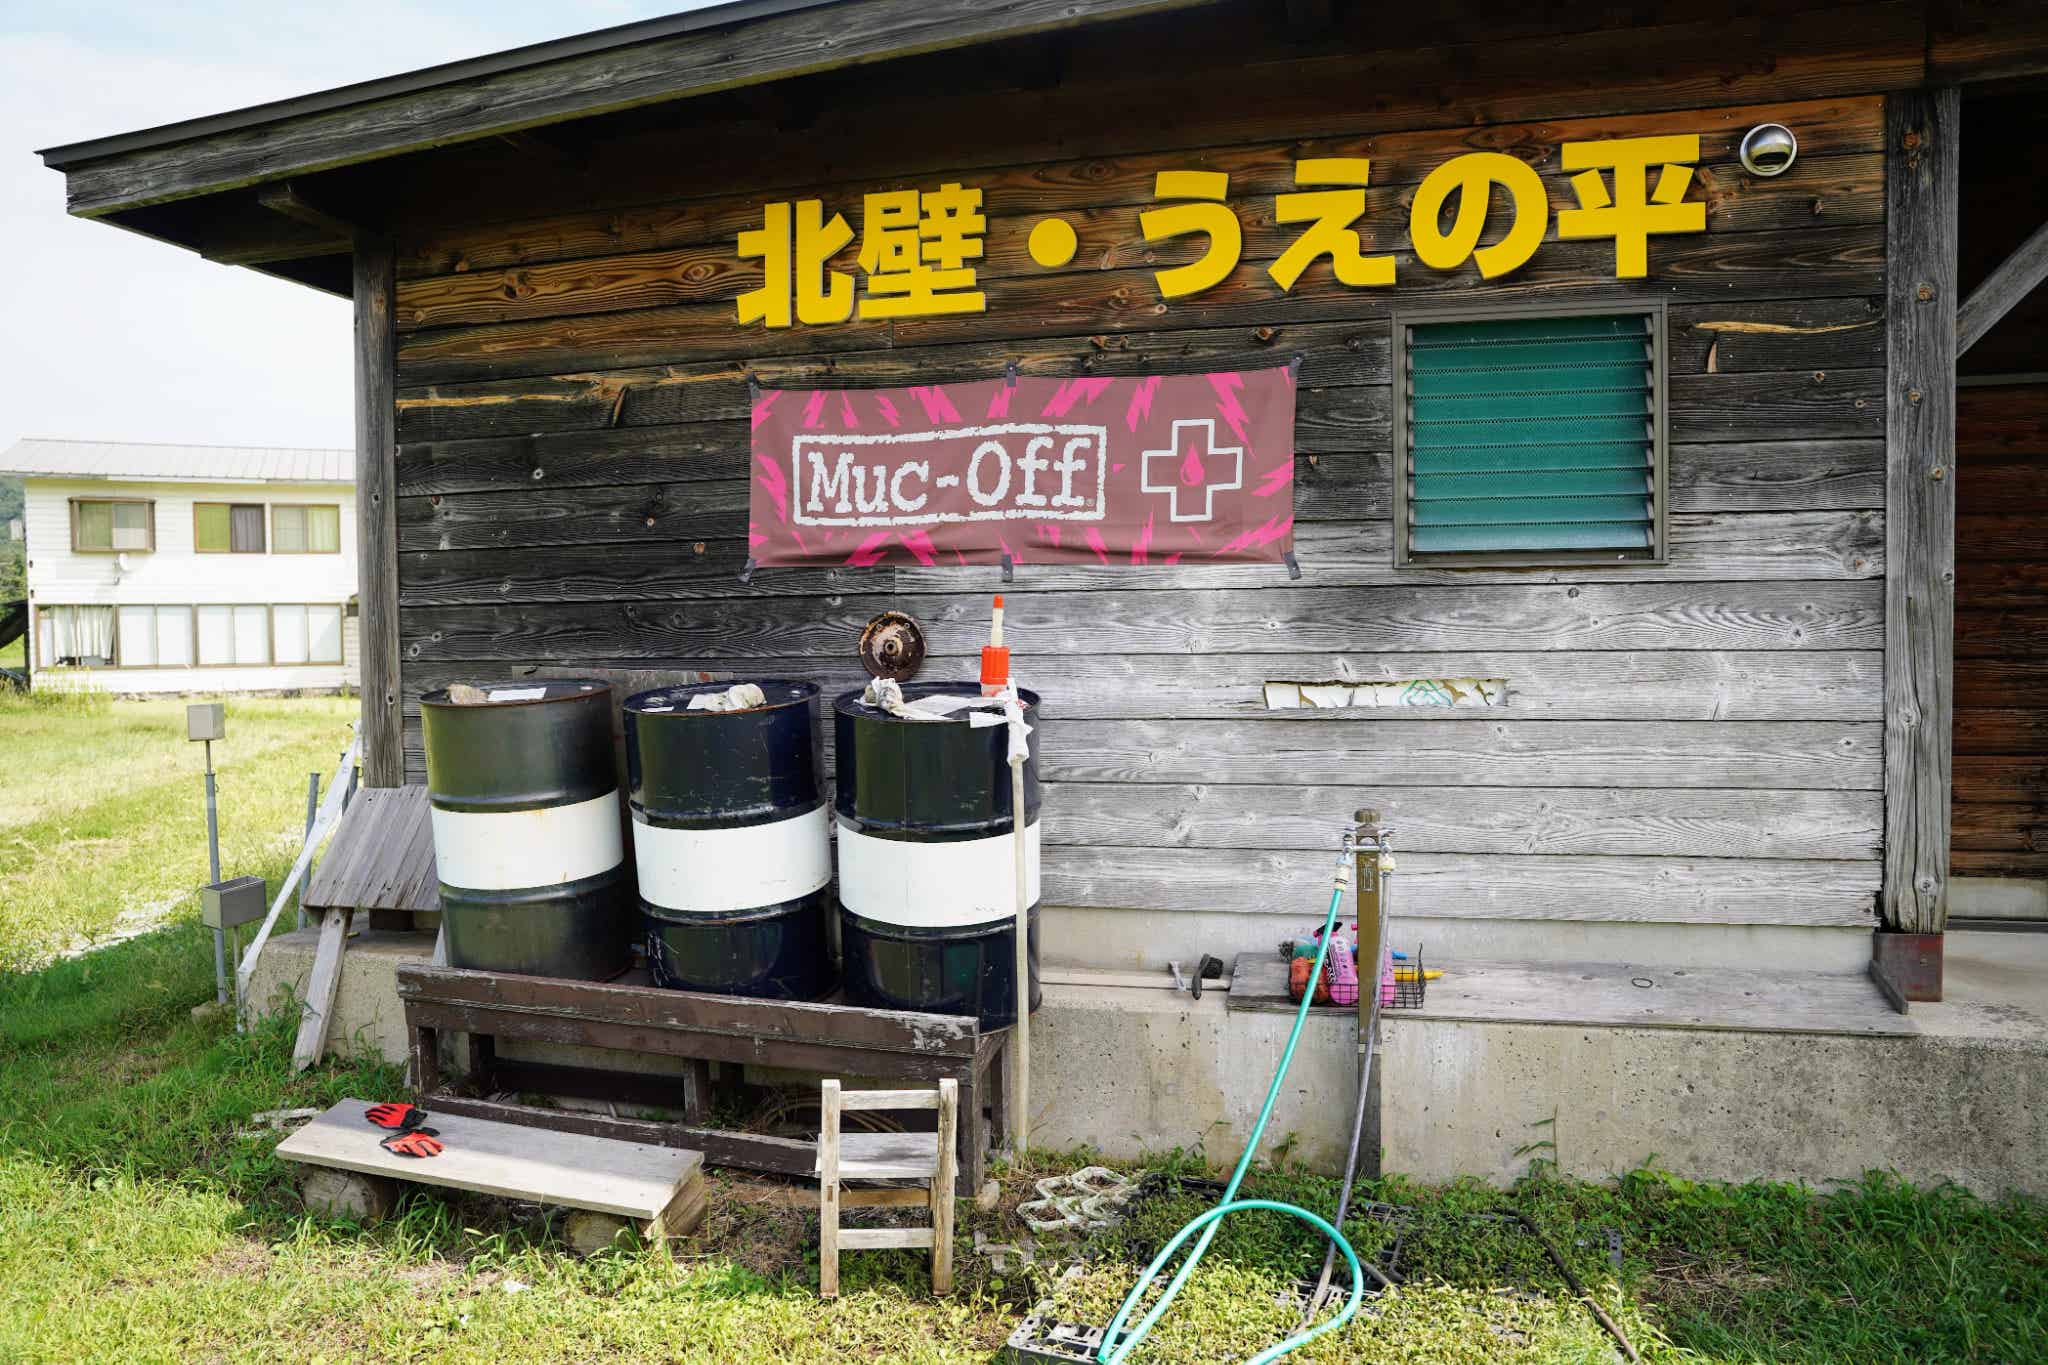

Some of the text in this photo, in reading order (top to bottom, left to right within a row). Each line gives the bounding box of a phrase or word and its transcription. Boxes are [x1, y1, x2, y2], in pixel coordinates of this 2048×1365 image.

[737, 134, 1707, 327] 北壁・うえの平
[806, 436, 1092, 513] Muc-Off
